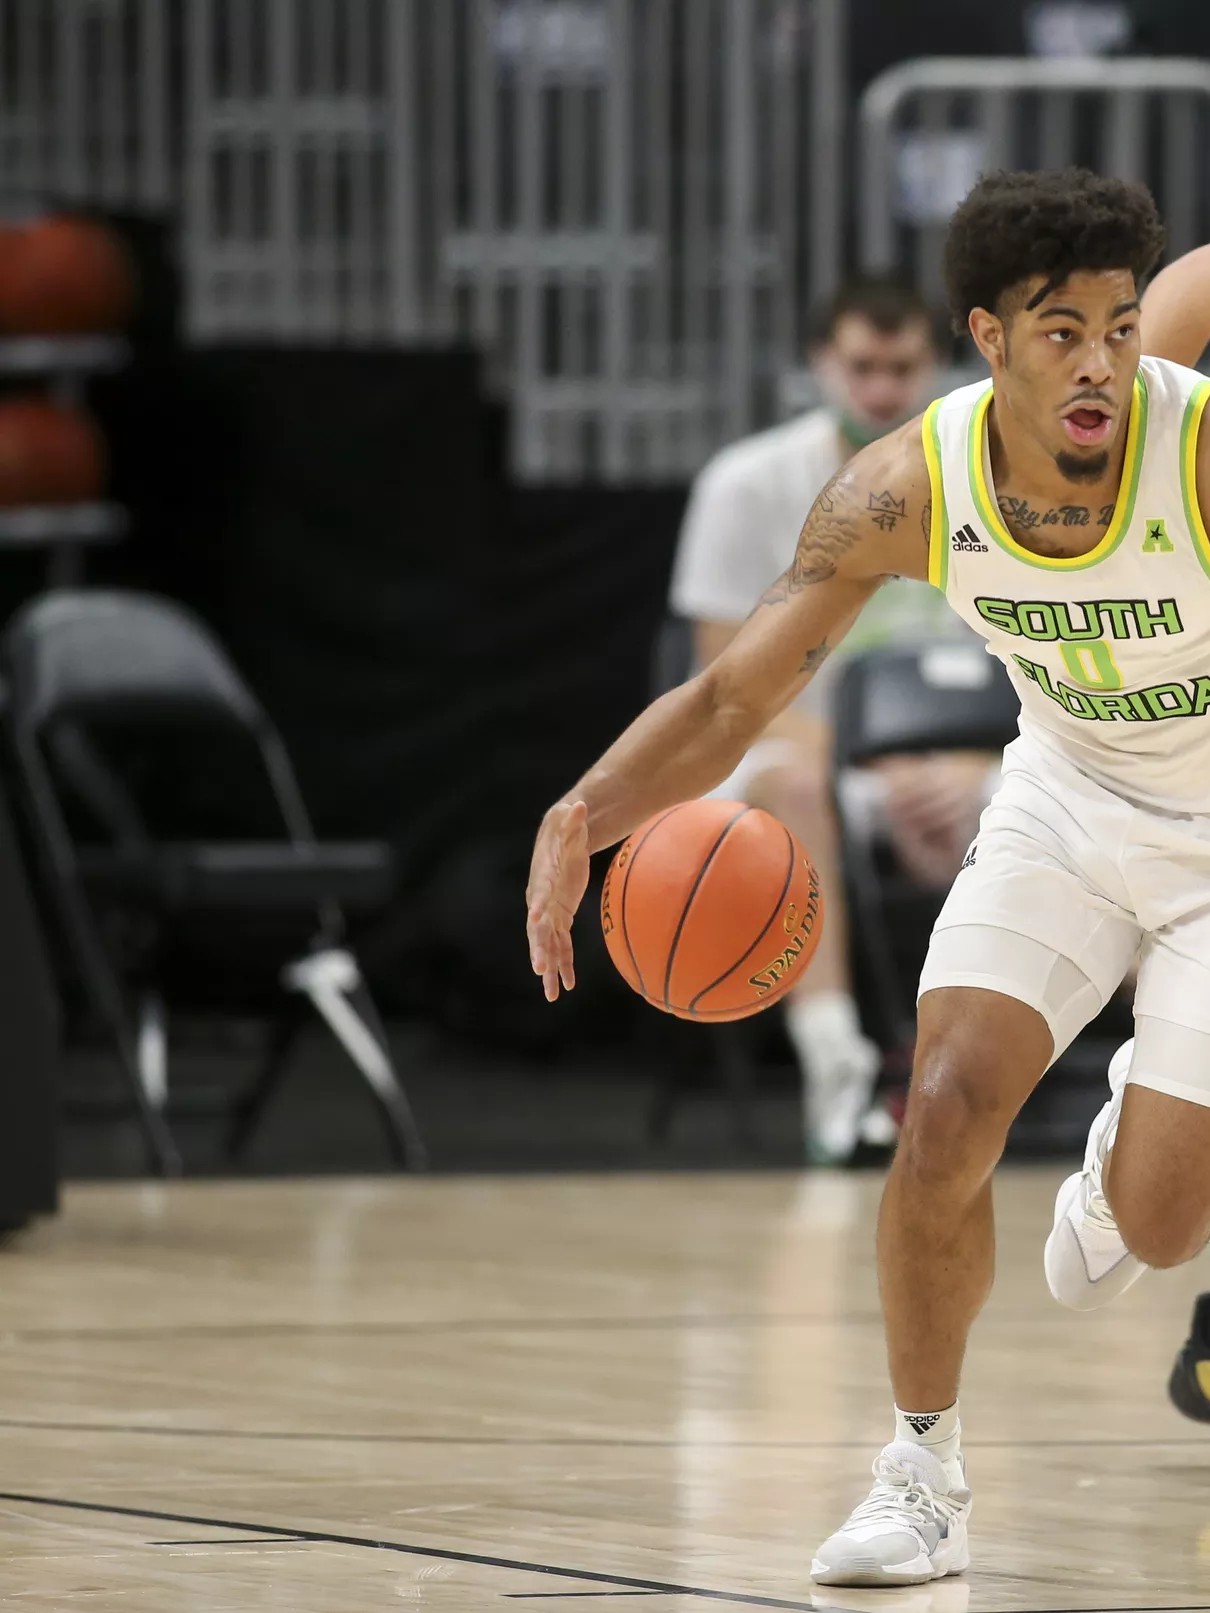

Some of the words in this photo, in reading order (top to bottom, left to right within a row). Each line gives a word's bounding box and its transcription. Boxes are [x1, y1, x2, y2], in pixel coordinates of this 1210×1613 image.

[974, 597, 1184, 641] SOUTH
[1058, 640, 1124, 691] 0
[748, 864, 821, 996] SPALDING
[903, 1414, 941, 1424] adidas
